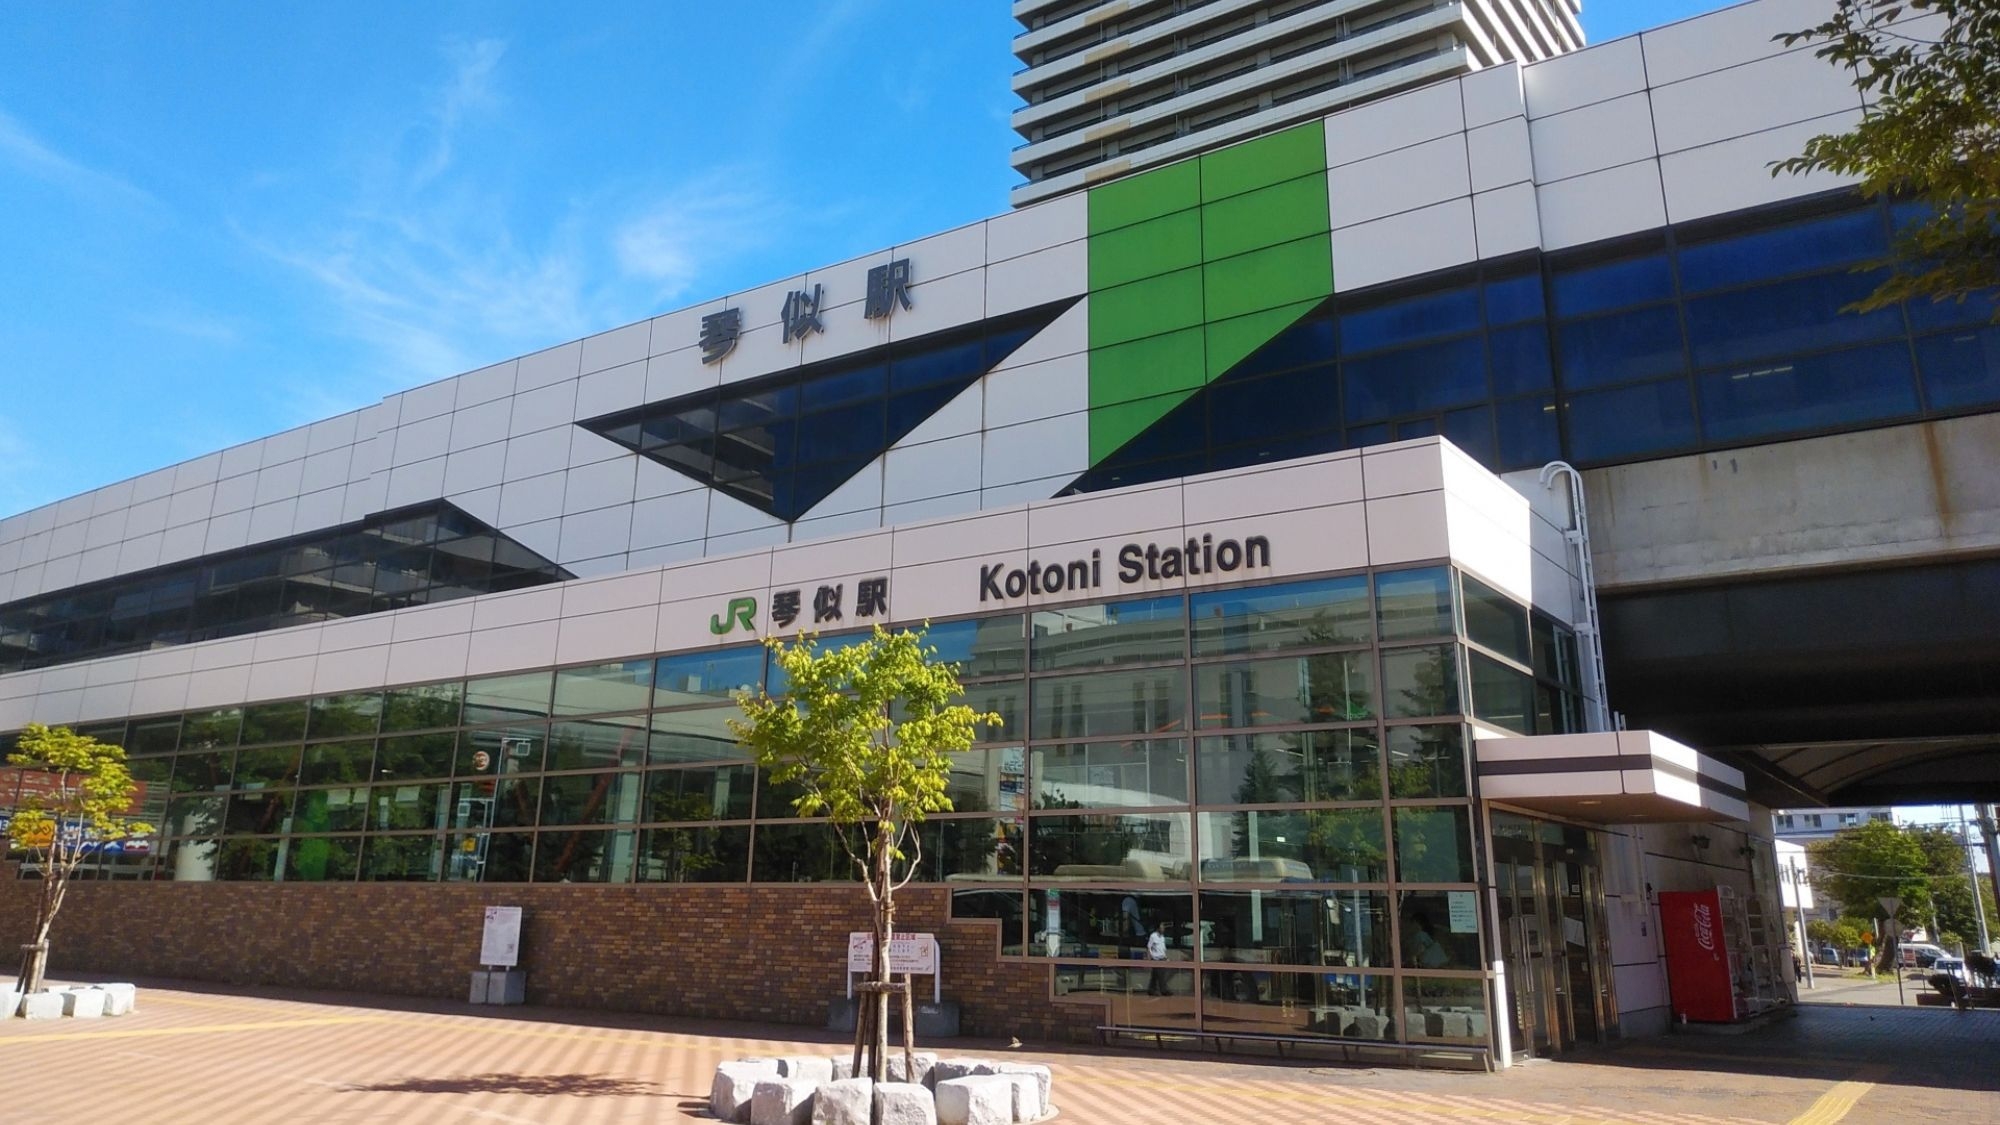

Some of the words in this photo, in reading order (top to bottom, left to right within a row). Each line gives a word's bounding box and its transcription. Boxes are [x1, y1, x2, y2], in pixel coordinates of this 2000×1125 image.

[699, 258, 912, 364] 琴似駅
[980, 548, 1101, 600] Kotoni
[1118, 532, 1271, 583] Station
[710, 596, 757, 635] JR
[771, 576, 888, 629] 琴似駅
[1693, 902, 1714, 950] Coca-Cola
